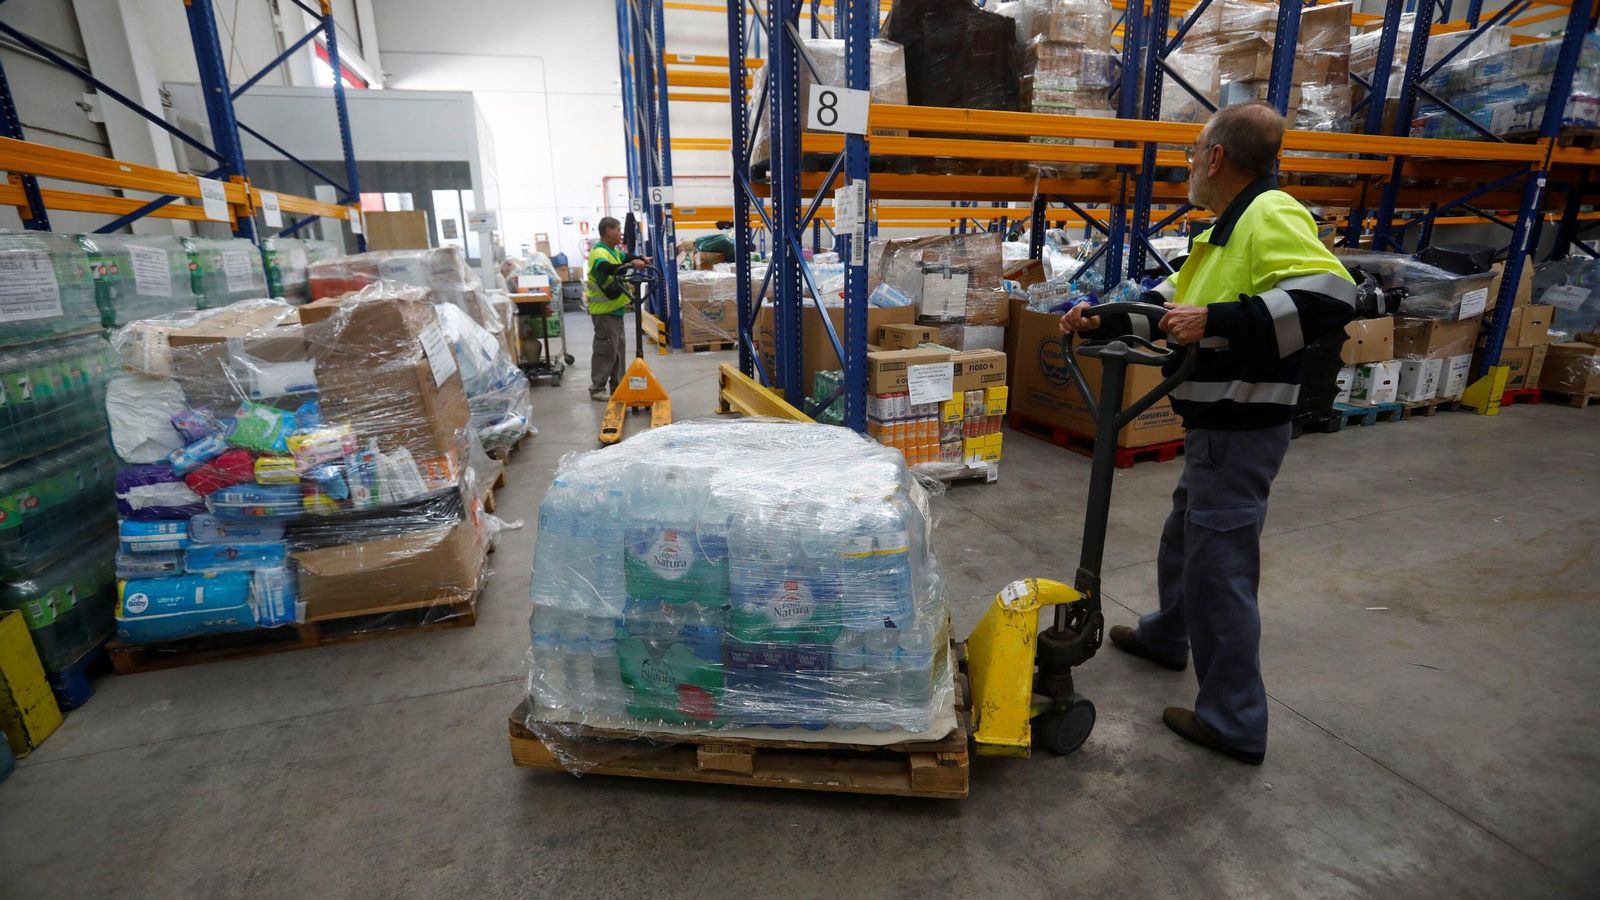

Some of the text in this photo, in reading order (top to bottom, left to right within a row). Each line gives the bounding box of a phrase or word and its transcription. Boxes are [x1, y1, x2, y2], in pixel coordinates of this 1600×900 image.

[816, 90, 838, 127] 8
[652, 188, 662, 203] 6
[633, 199, 641, 212] 5
[968, 363, 988, 372] FIDEO
[1137, 410, 1169, 421] CONSERVAS
[654, 555, 687, 569] Natura
[773, 605, 809, 618] Natura
